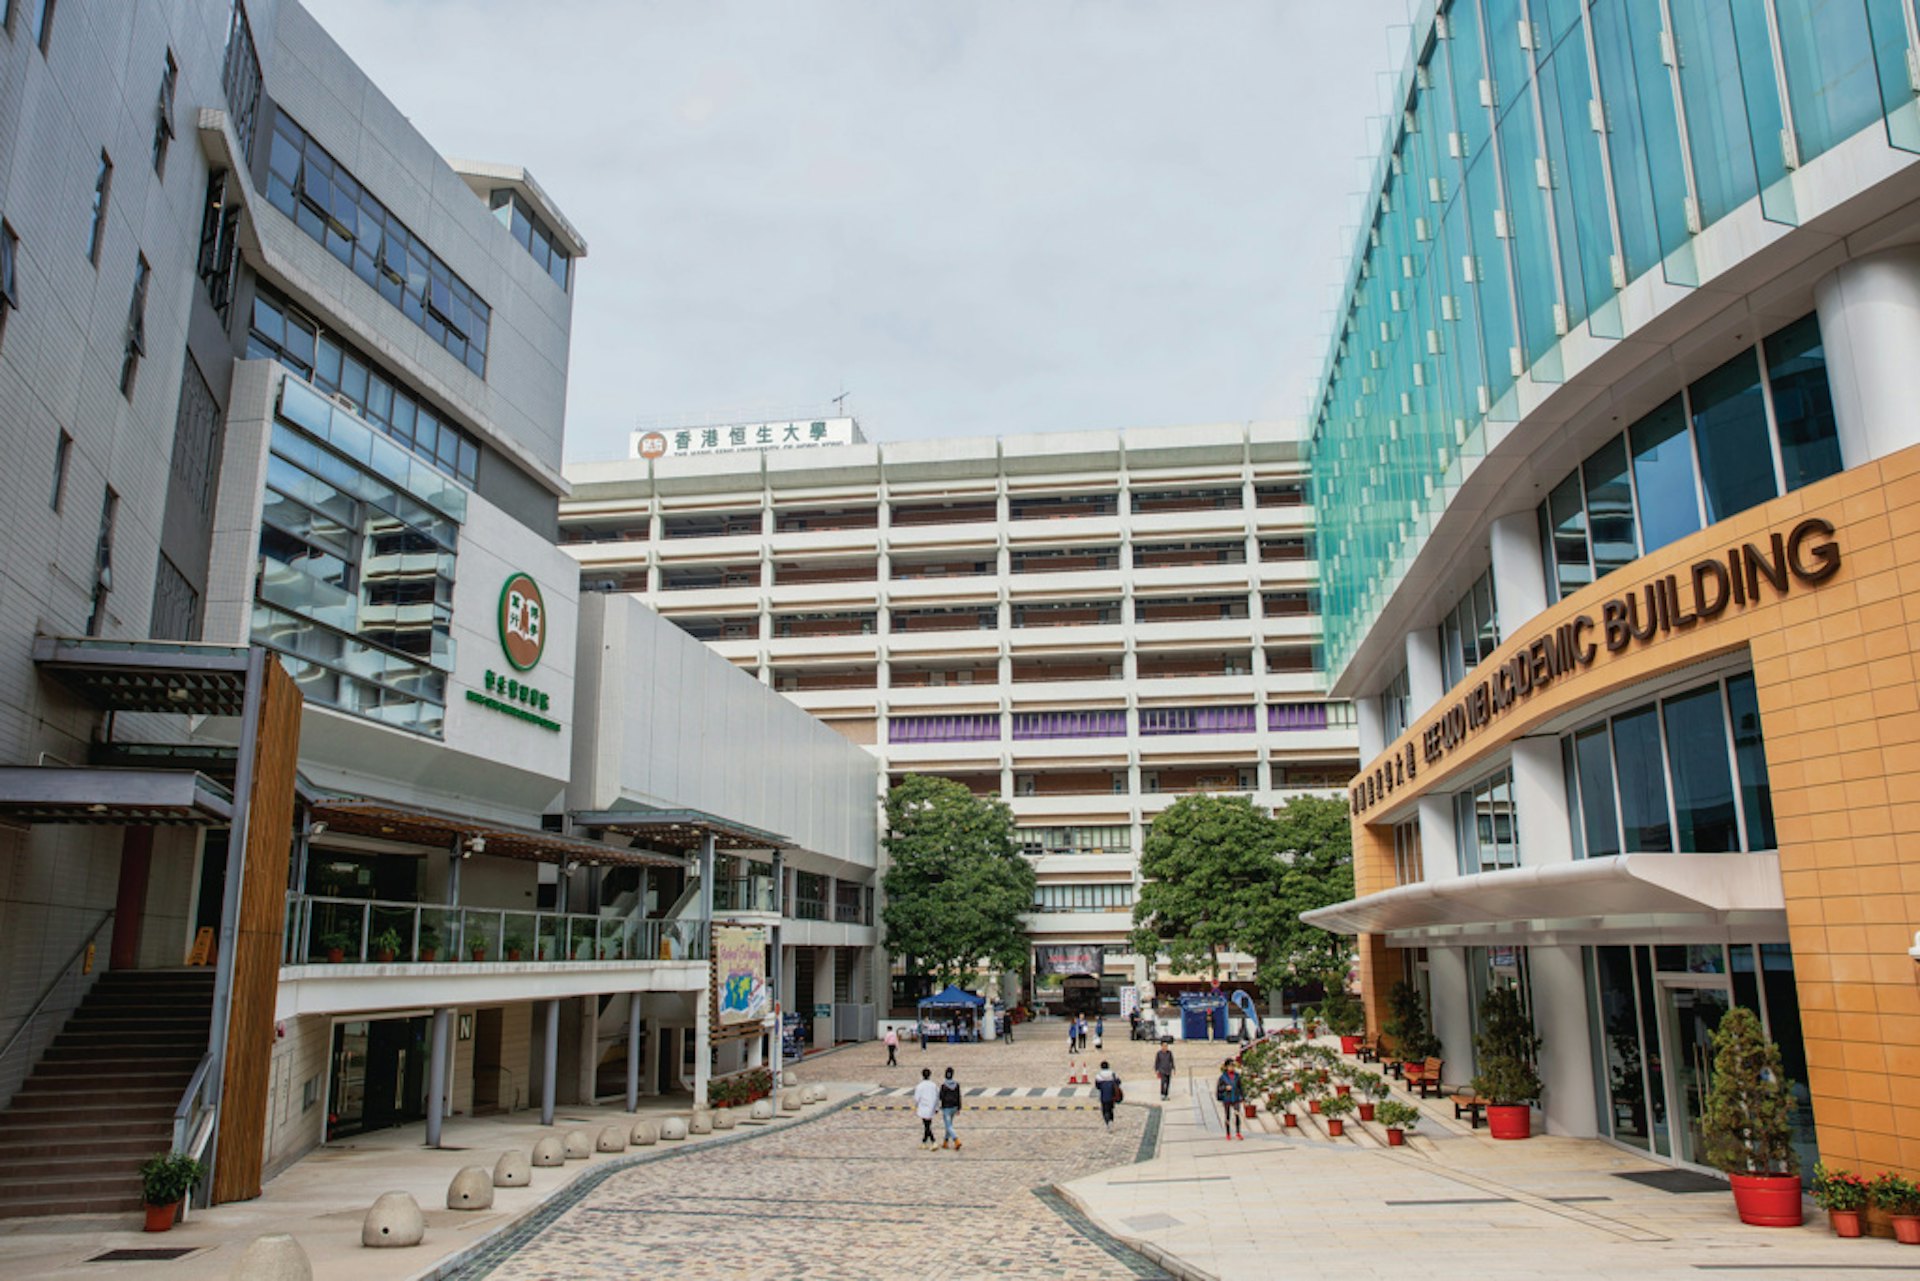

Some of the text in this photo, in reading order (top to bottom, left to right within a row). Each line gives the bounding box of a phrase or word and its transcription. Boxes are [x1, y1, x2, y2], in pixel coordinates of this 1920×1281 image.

[674, 421, 828, 450] 香港恒生大學
[1423, 722, 1442, 764] LEE
[1465, 681, 1491, 731] WEI
[1492, 614, 1598, 715] ACADEMIC
[1603, 517, 1841, 652] BUILDING
[460, 1015, 472, 1039] N
